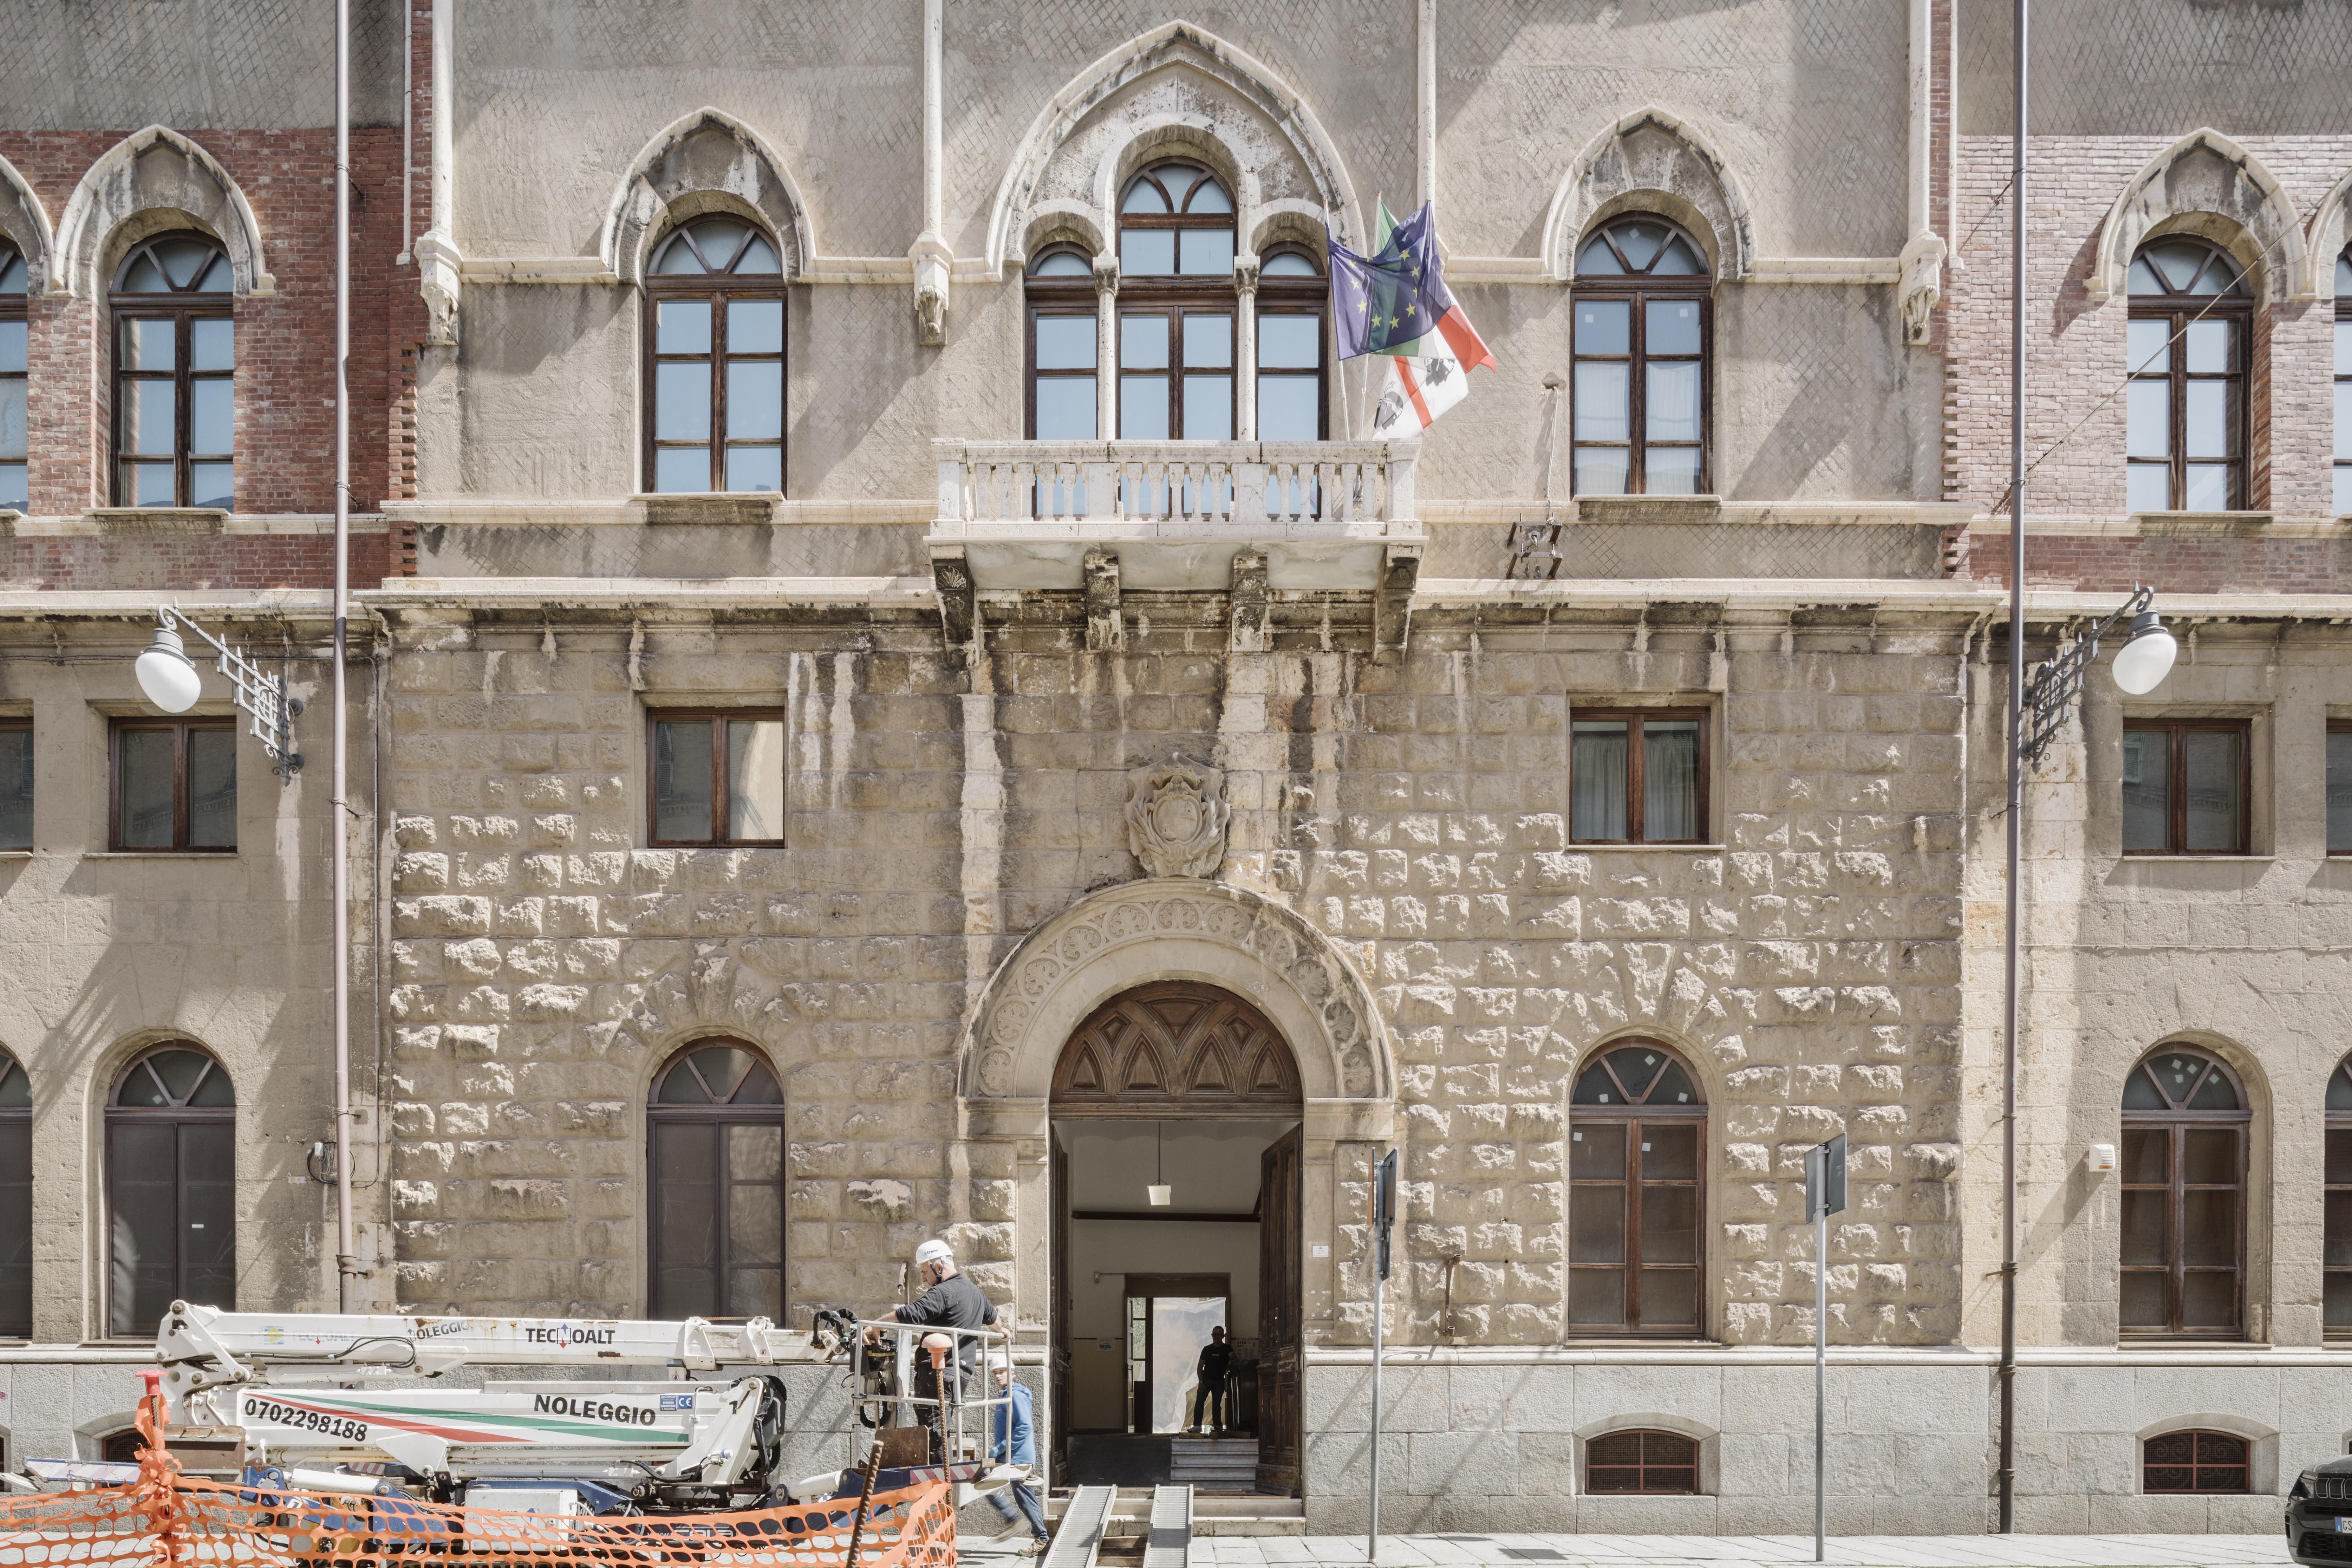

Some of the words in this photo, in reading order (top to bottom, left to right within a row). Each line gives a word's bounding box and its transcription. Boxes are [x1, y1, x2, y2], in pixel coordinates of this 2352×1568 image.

[534, 1394, 656, 1426] NOLEGGIO
[679, 1397, 691, 1407] CE
[245, 1399, 367, 1442] 0702298188
